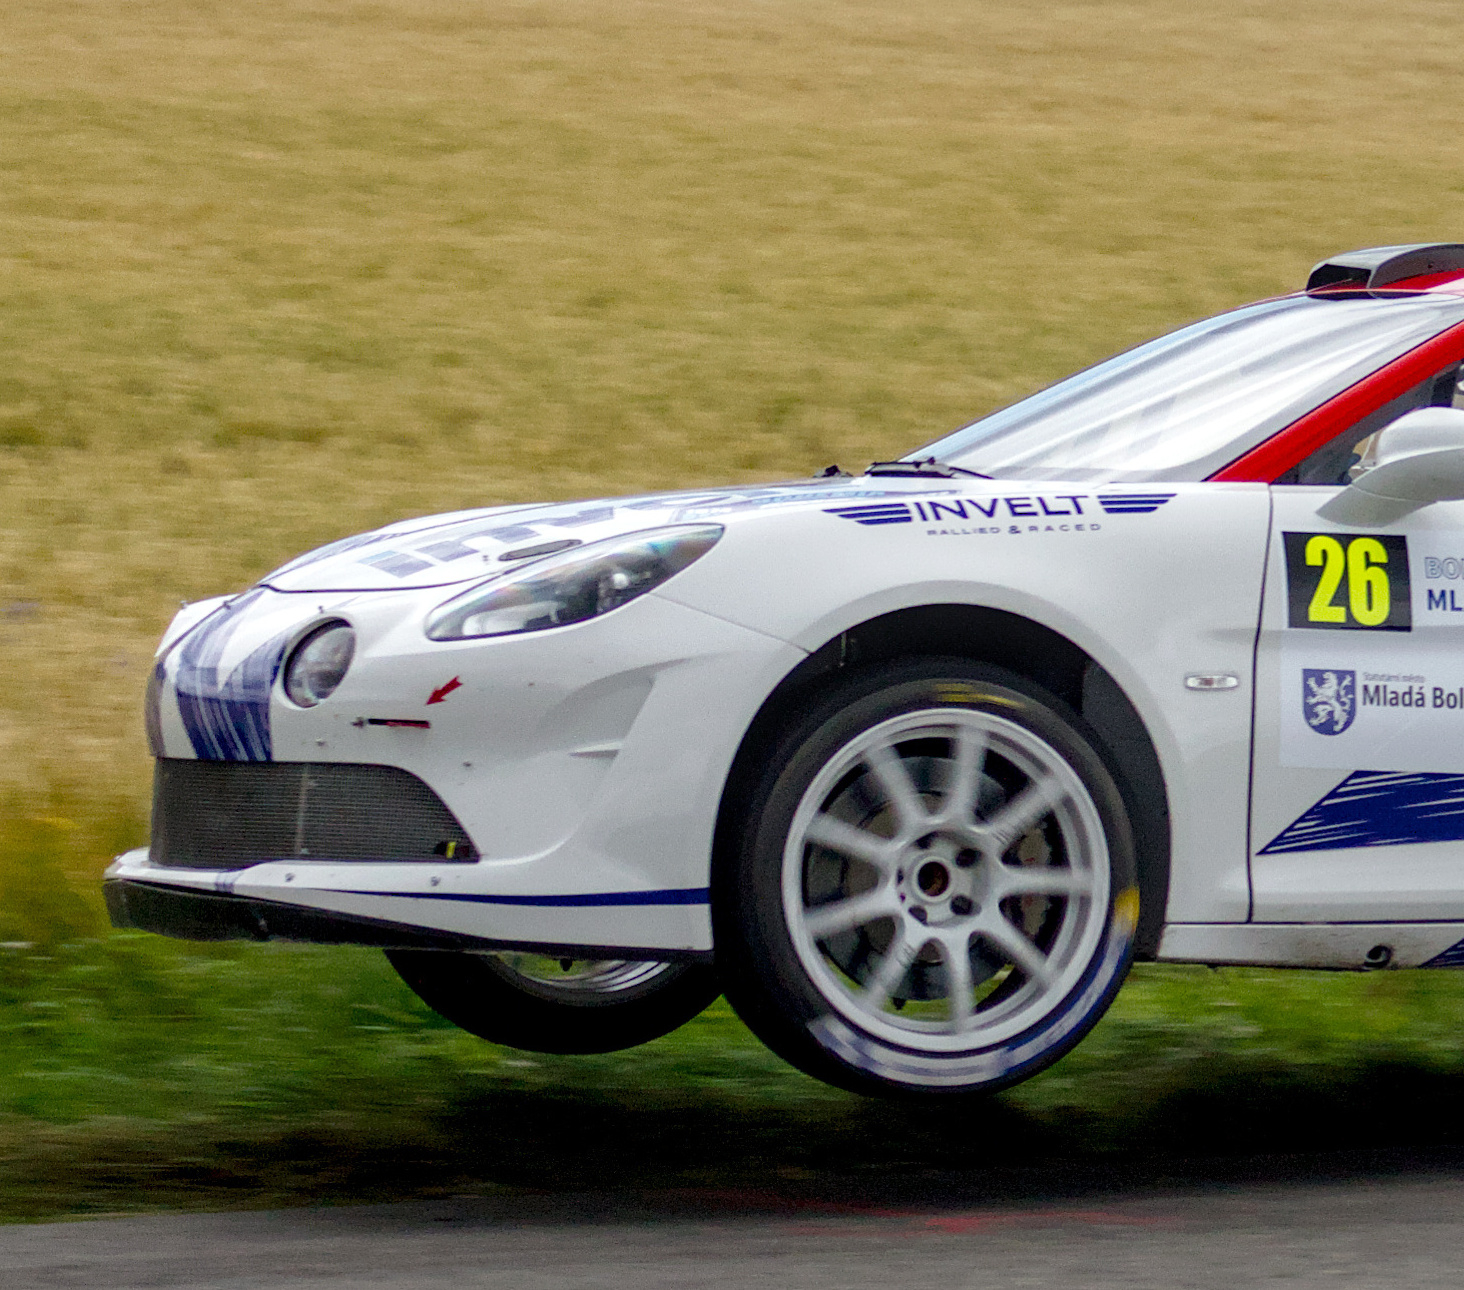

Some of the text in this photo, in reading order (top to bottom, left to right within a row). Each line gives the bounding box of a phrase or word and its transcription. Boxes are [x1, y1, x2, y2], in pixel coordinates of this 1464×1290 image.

[912, 494, 1089, 522] INVELT
[927, 523, 1102, 537] RALLIED & RACED
[1304, 535, 1391, 626] 26
[1362, 684, 1426, 708] Mladá
